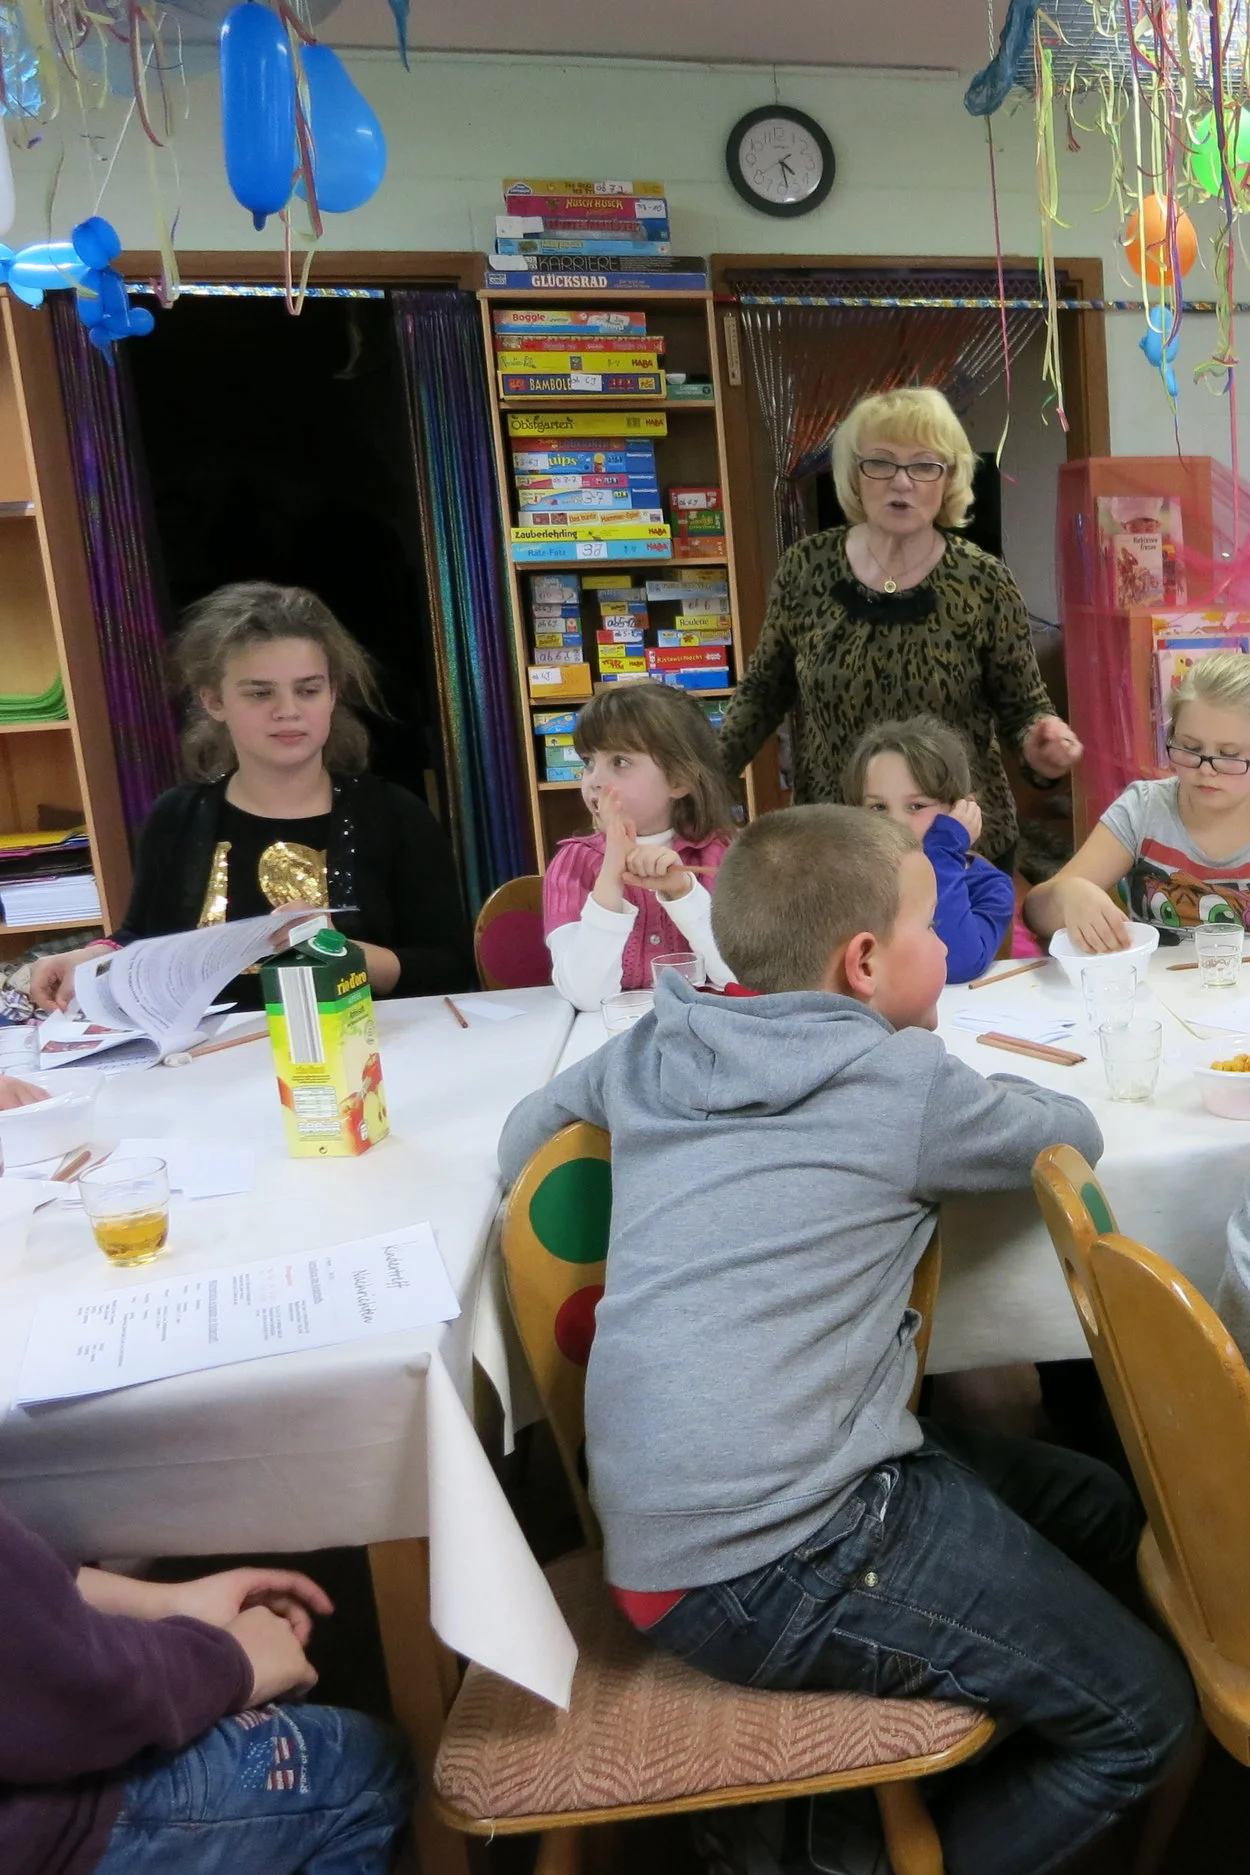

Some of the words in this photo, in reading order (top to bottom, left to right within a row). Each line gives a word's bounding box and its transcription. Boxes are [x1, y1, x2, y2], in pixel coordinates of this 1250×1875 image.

[566, 198, 593, 209] HUSCH
[595, 198, 624, 210] HUSCH
[541, 256, 619, 271] KARRIERE
[532, 274, 608, 289] GLÜCKSRAD
[513, 313, 546, 323] Boggle
[632, 359, 653, 368] HABA
[511, 416, 573, 432] Obstgarten
[646, 419, 664, 427] HABA
[515, 528, 578, 540] Zauberlehrling
[648, 527, 667, 536] HABA
[646, 542, 668, 552] HABA
[352, 1269, 376, 1324] Nachrichten
